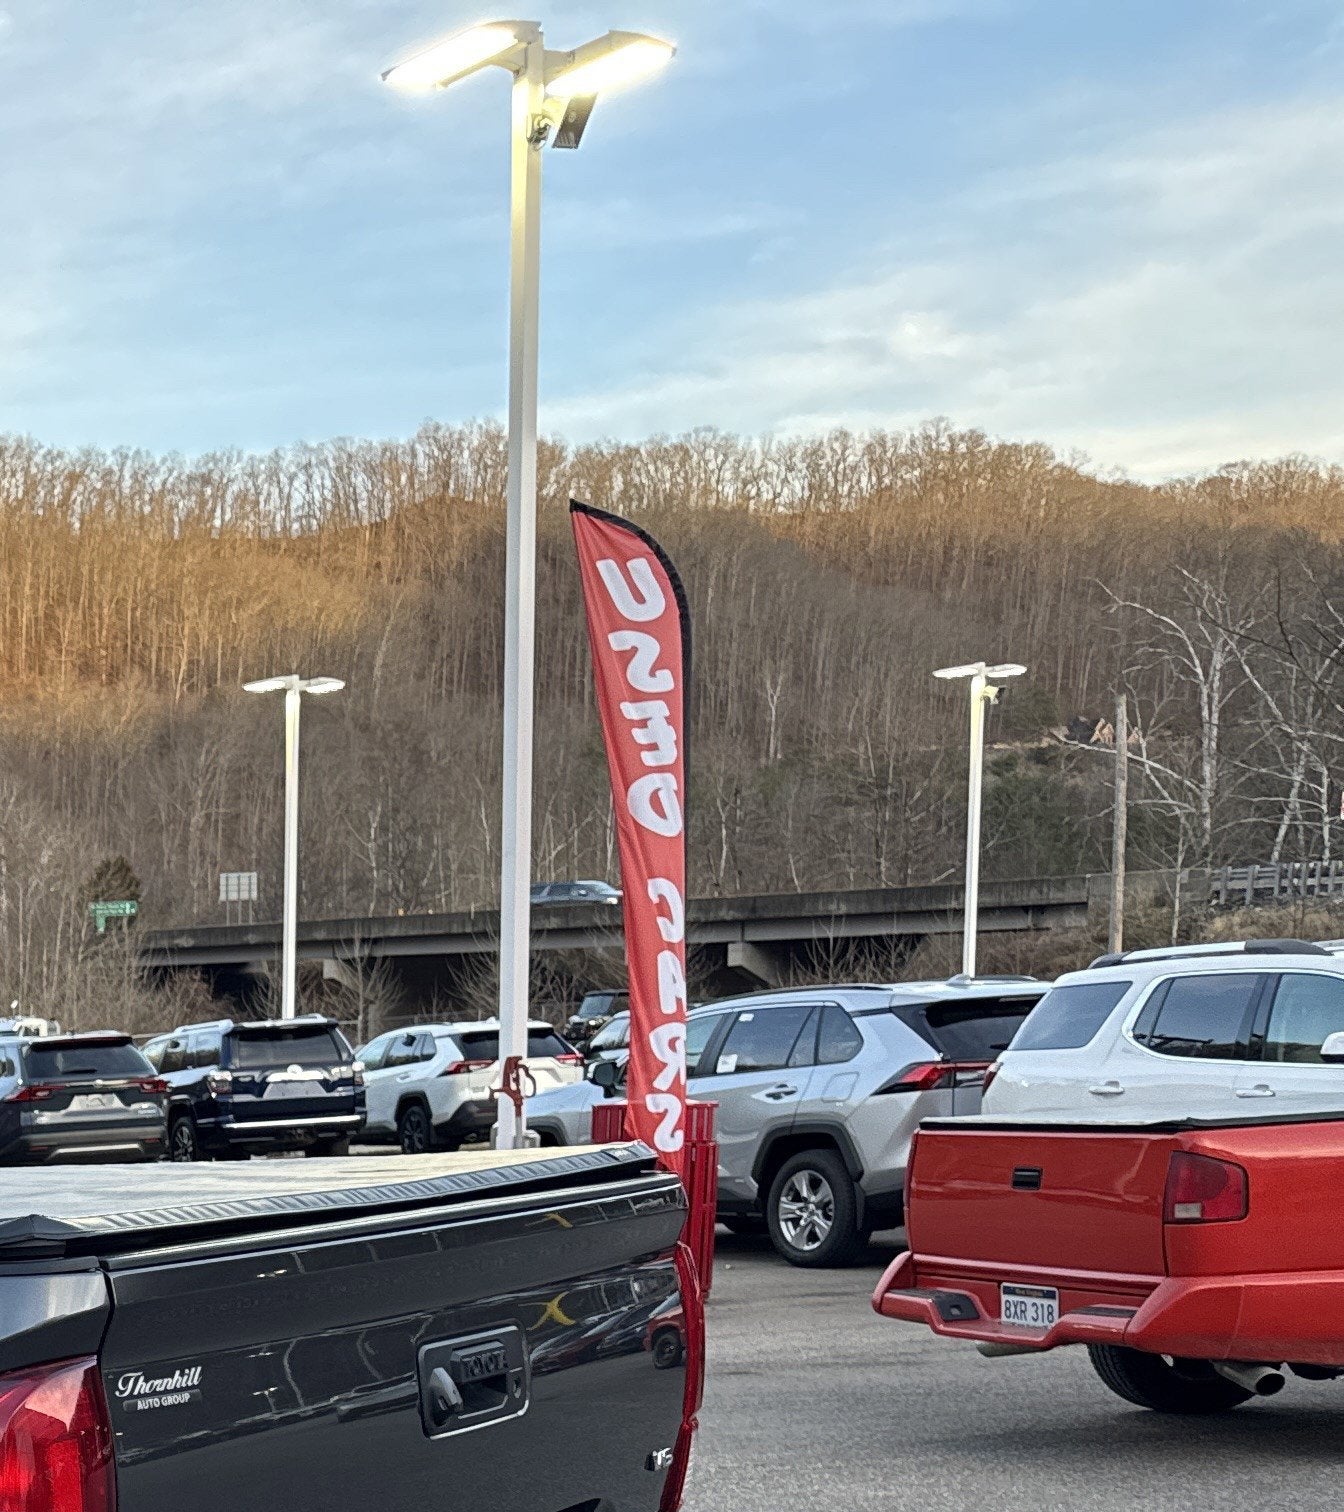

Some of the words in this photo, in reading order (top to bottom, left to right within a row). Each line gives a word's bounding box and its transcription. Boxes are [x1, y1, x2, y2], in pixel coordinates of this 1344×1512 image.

[1031, 1302, 1054, 1323] 318
[115, 1366, 202, 1398] Thornhill
[137, 1397, 160, 1411] AUTO
[161, 1392, 191, 1407] GROUP
